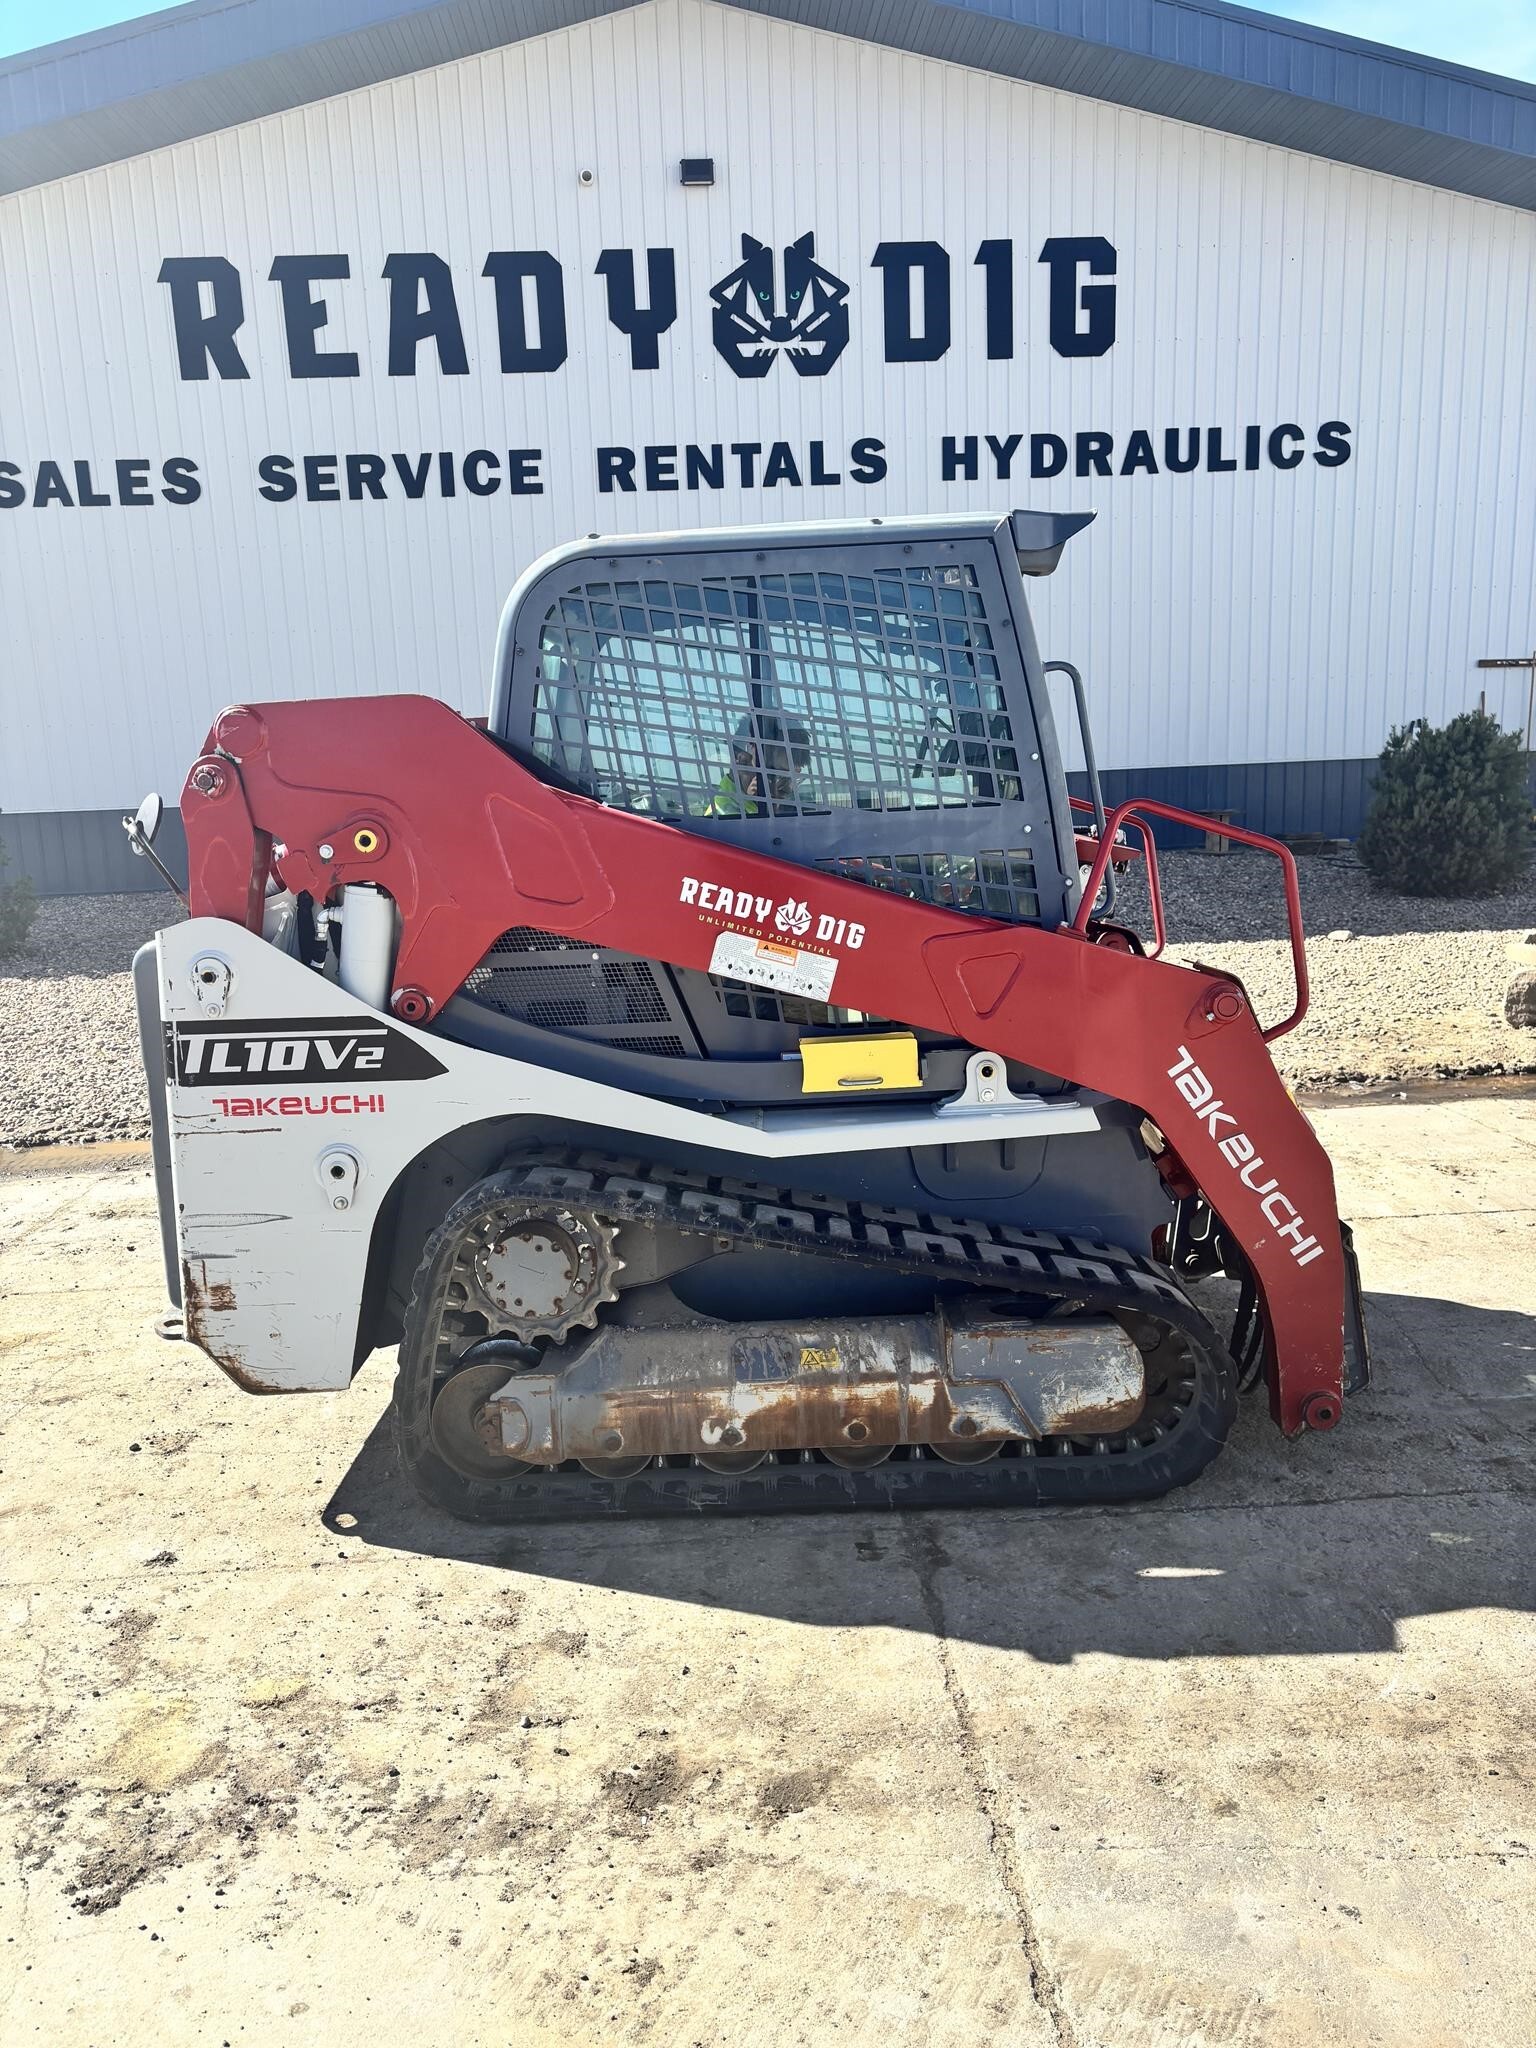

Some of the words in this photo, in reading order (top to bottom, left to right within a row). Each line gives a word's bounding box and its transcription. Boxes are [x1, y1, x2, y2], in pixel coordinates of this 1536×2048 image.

[157, 247, 678, 381] READY
[870, 236, 1118, 363] DIG
[0, 457, 202, 509] SALES
[258, 449, 545, 502] SERVICE
[596, 437, 889, 493] RENTALS
[942, 420, 1353, 481] HYDRAULICS
[679, 876, 773, 923] READY
[815, 913, 866, 950] DIG
[698, 914, 763, 937] UNLIMITED
[768, 932, 833, 956] POTENTIAL
[178, 1028, 389, 1075] TL10V2
